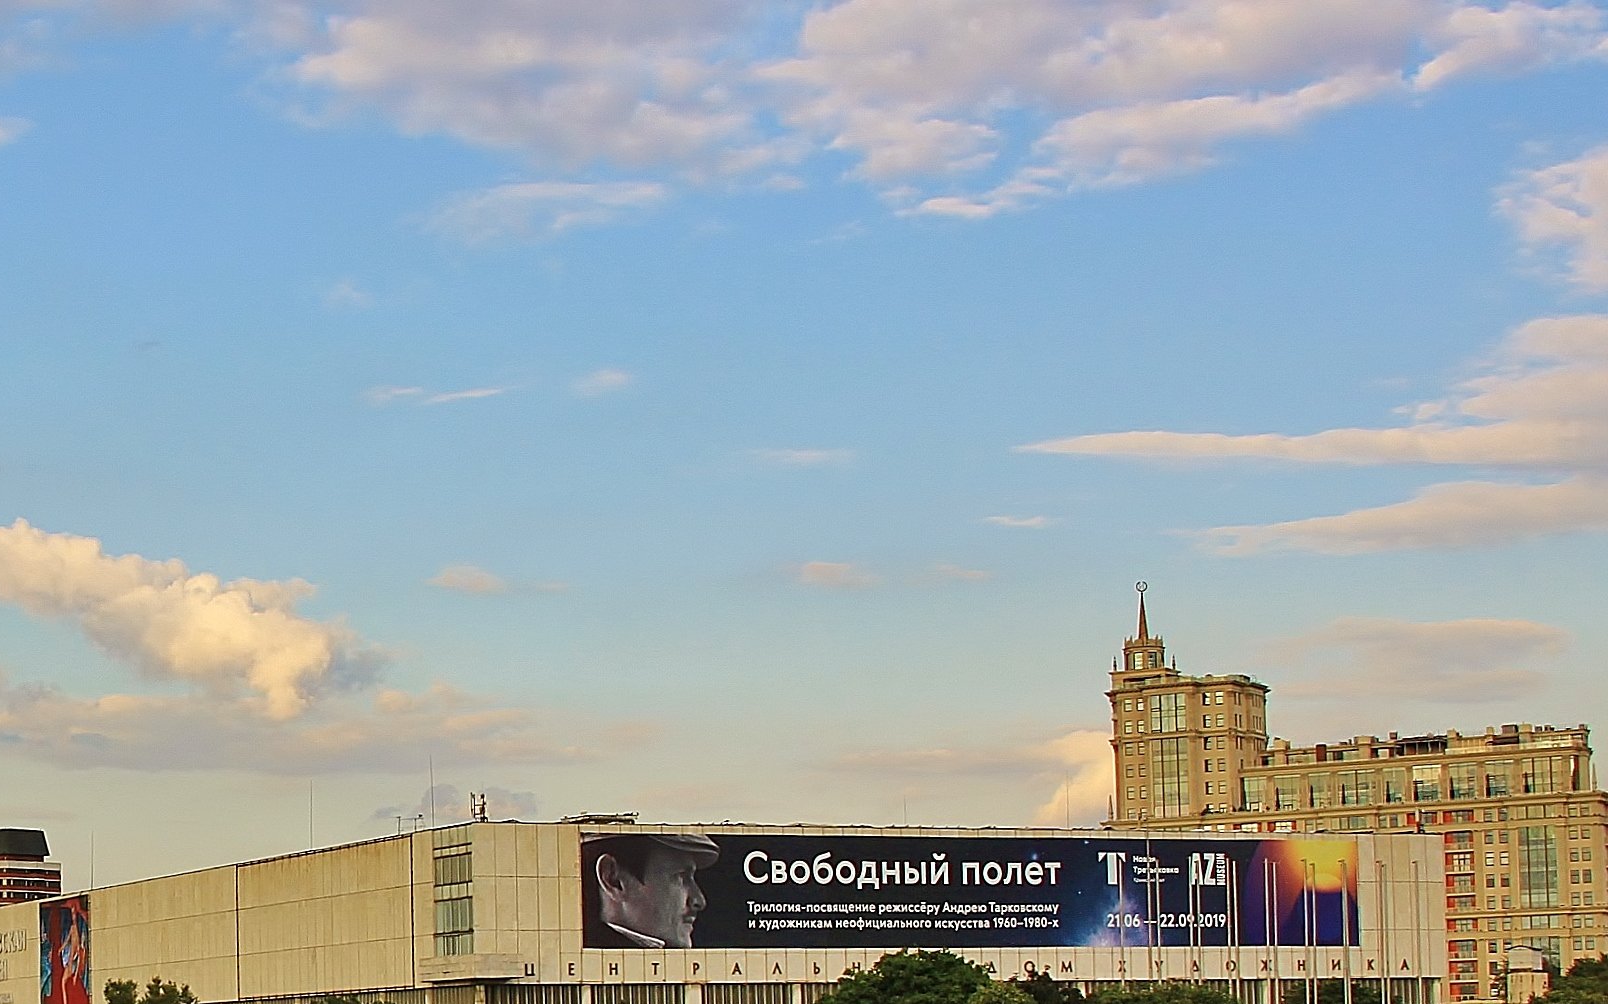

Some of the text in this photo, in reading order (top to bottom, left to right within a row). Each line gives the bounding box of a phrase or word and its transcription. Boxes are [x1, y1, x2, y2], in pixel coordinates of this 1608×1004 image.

[743, 851, 1061, 890] Свободный полет
[1191, 852, 1216, 885] AZ
[1215, 853, 1226, 886] MUSEUM
[747, 901, 876, 915] Трилогия-посвящение
[942, 902, 987, 915] Андрею
[988, 901, 1060, 915] Тарковскому
[748, 918, 756, 929] и
[758, 918, 833, 931] художникам
[835, 917, 932, 931] неофициального
[934, 918, 991, 931] искусства
[1107, 913, 1140, 928] 2106
[1159, 913, 1227, 928] 22.09.2019
[524, 961, 861, 977] ЦЕНТРАЛЬН
[1118, 959, 1410, 972] ХУДОЖНИКА
